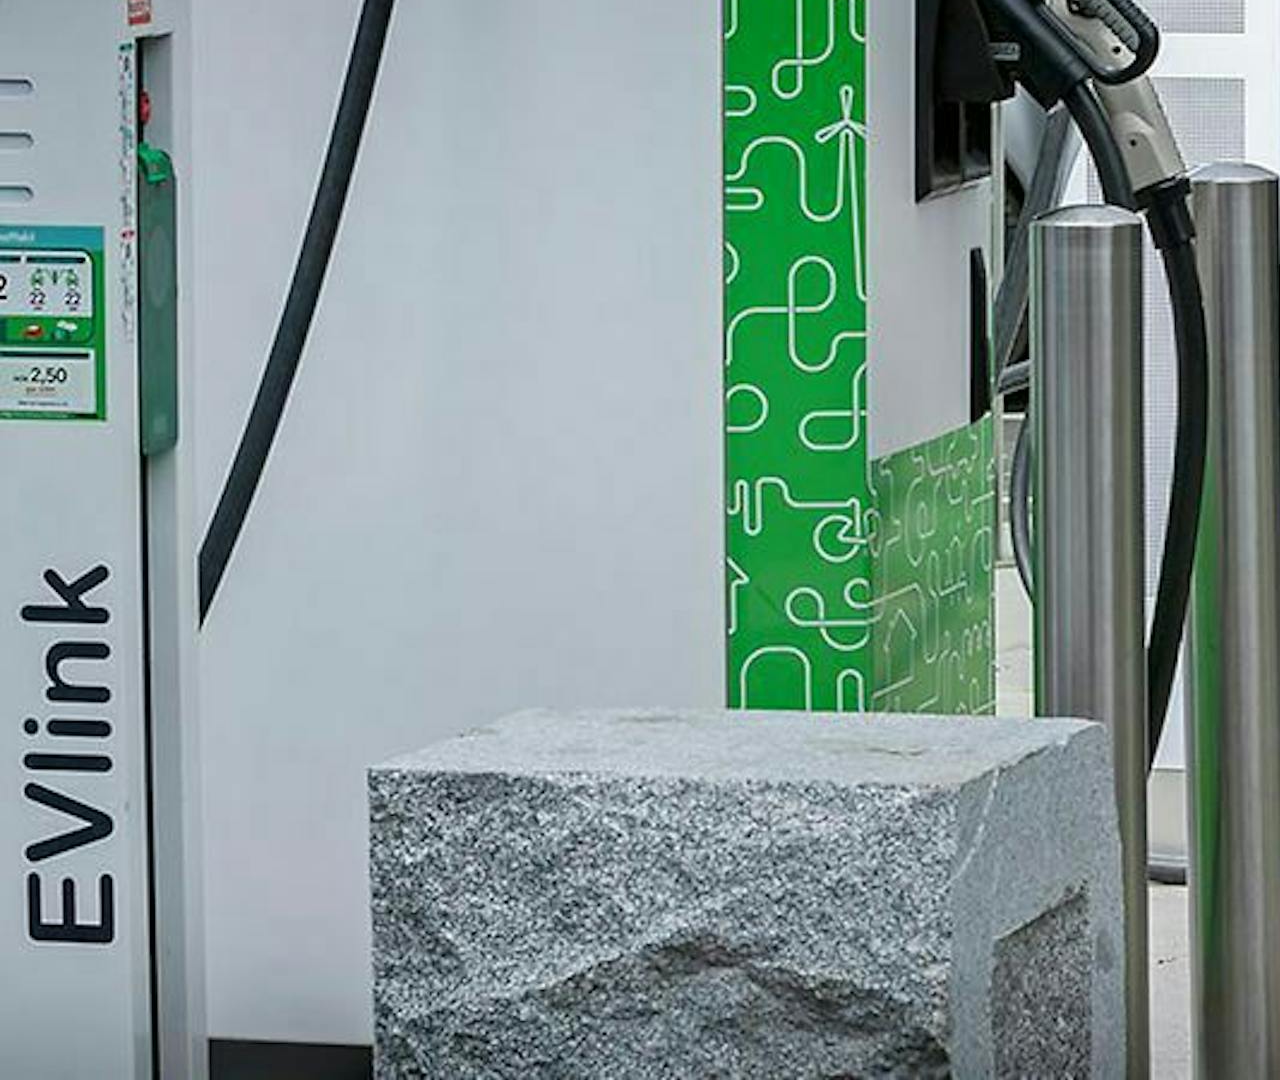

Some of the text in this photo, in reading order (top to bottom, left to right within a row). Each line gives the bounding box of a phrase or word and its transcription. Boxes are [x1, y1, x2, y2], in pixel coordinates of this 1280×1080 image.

[28, 291, 47, 306] 22
[64, 291, 82, 306] 22
[30, 366, 68, 385] 2,50
[20, 564, 114, 944] EVlink
